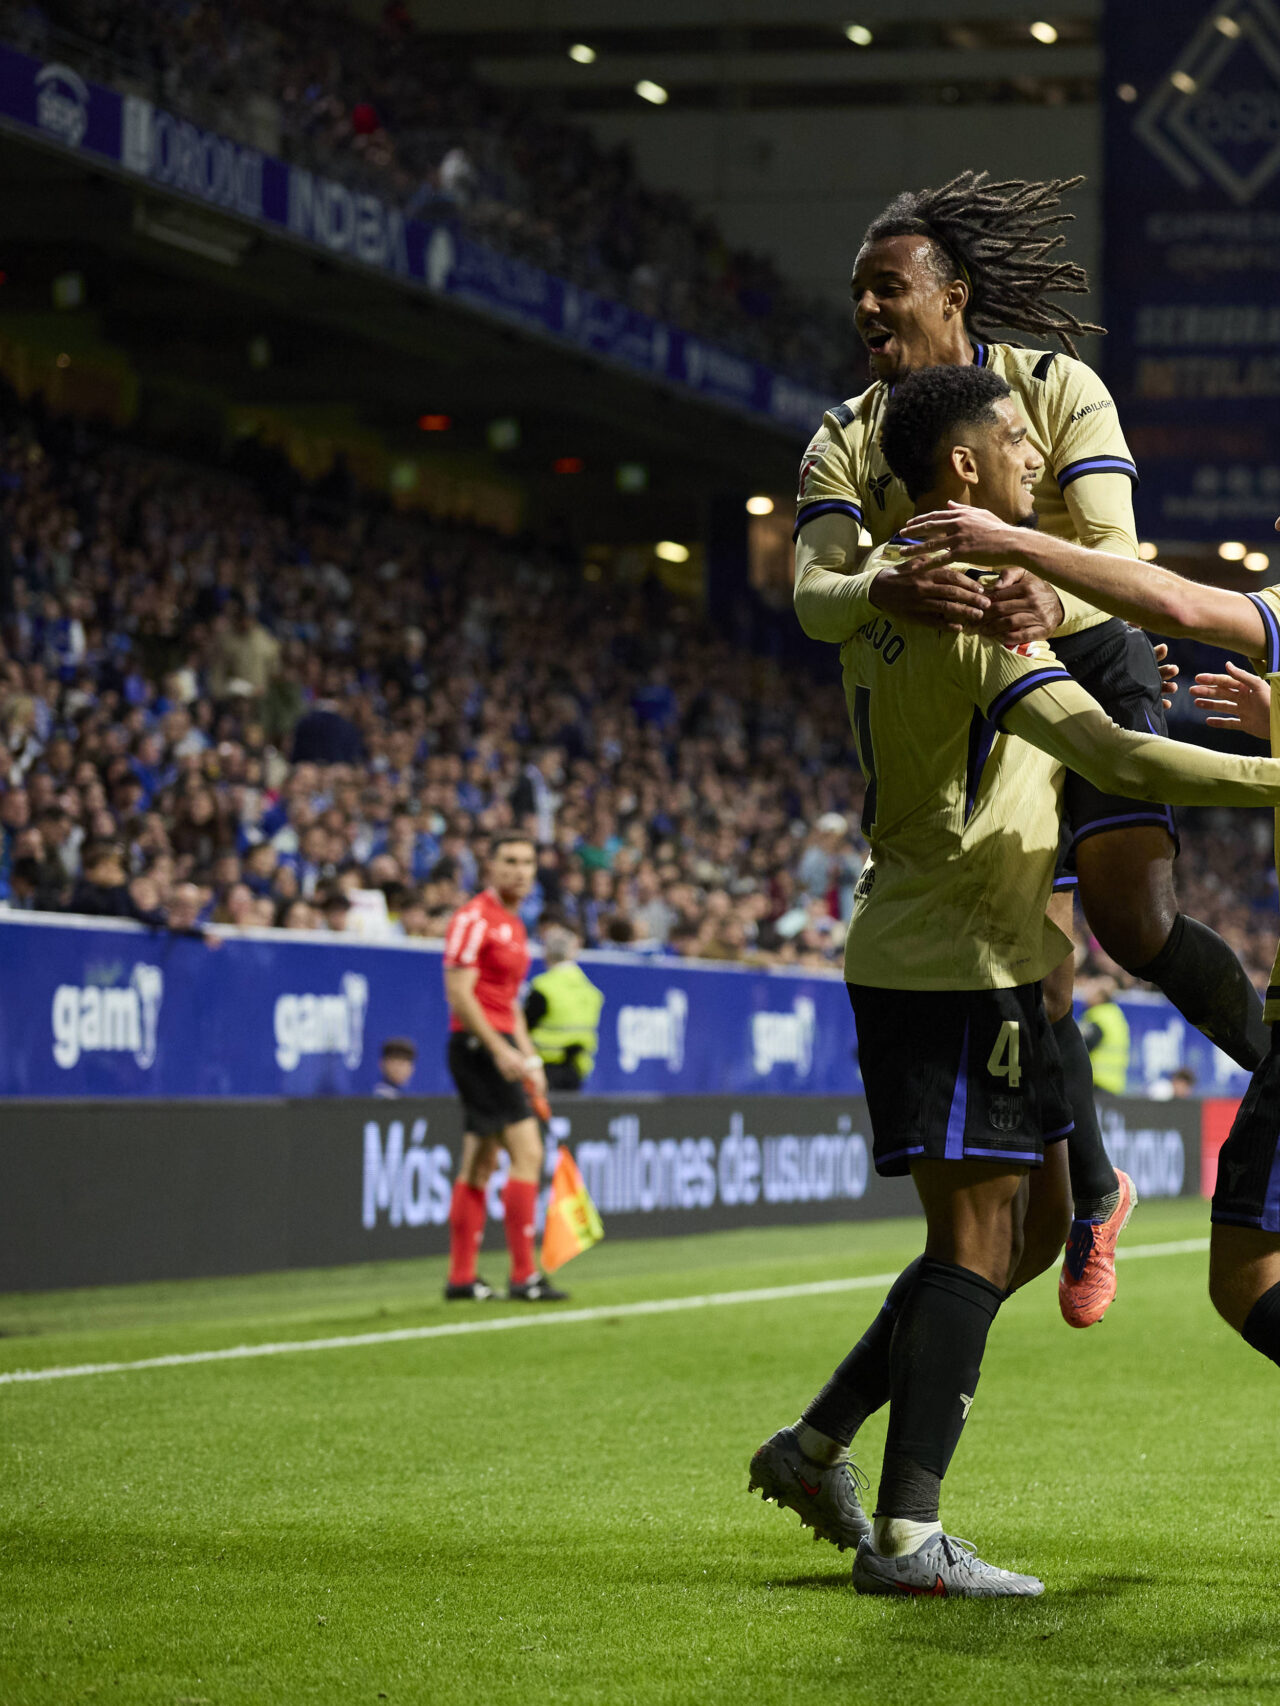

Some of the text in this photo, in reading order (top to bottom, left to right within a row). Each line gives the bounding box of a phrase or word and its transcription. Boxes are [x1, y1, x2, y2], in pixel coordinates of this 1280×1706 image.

[987, 1020, 1022, 1088] 4
[362, 1117, 452, 1230] Más
[718, 1111, 760, 1206] de
